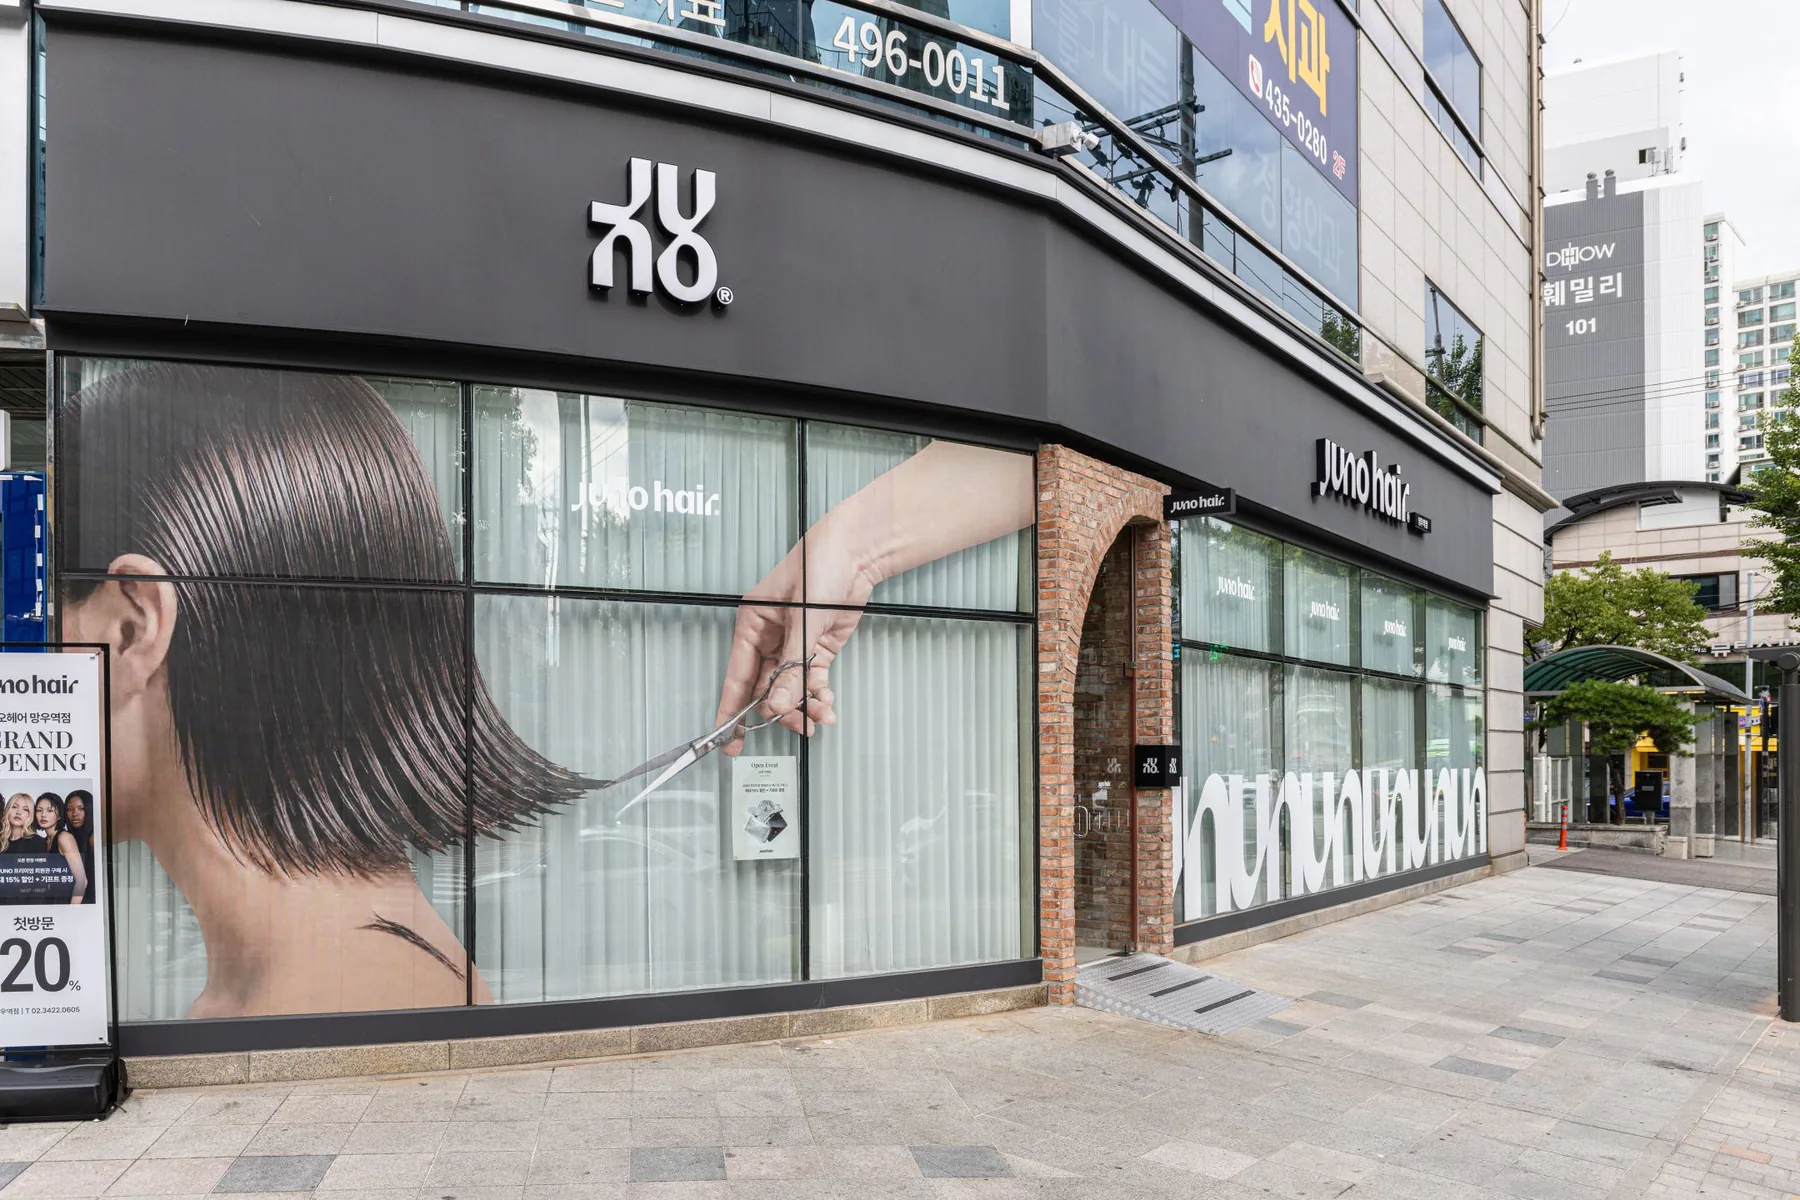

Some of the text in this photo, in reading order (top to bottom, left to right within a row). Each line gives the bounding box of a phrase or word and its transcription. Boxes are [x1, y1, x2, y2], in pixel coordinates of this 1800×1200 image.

[833, 16, 1010, 110] 496-0011
[1265, 79, 1345, 180] 435-0280 2F
[1543, 272, 1622, 306] 훼밀리
[1565, 317, 1597, 336] 101
[0, 674, 79, 694] no hair
[30, 712, 71, 724] 망우역점
[0, 730, 73, 749] RAND
[41, 875, 60, 883] 기프트
[13, 916, 55, 931] 첫방문
